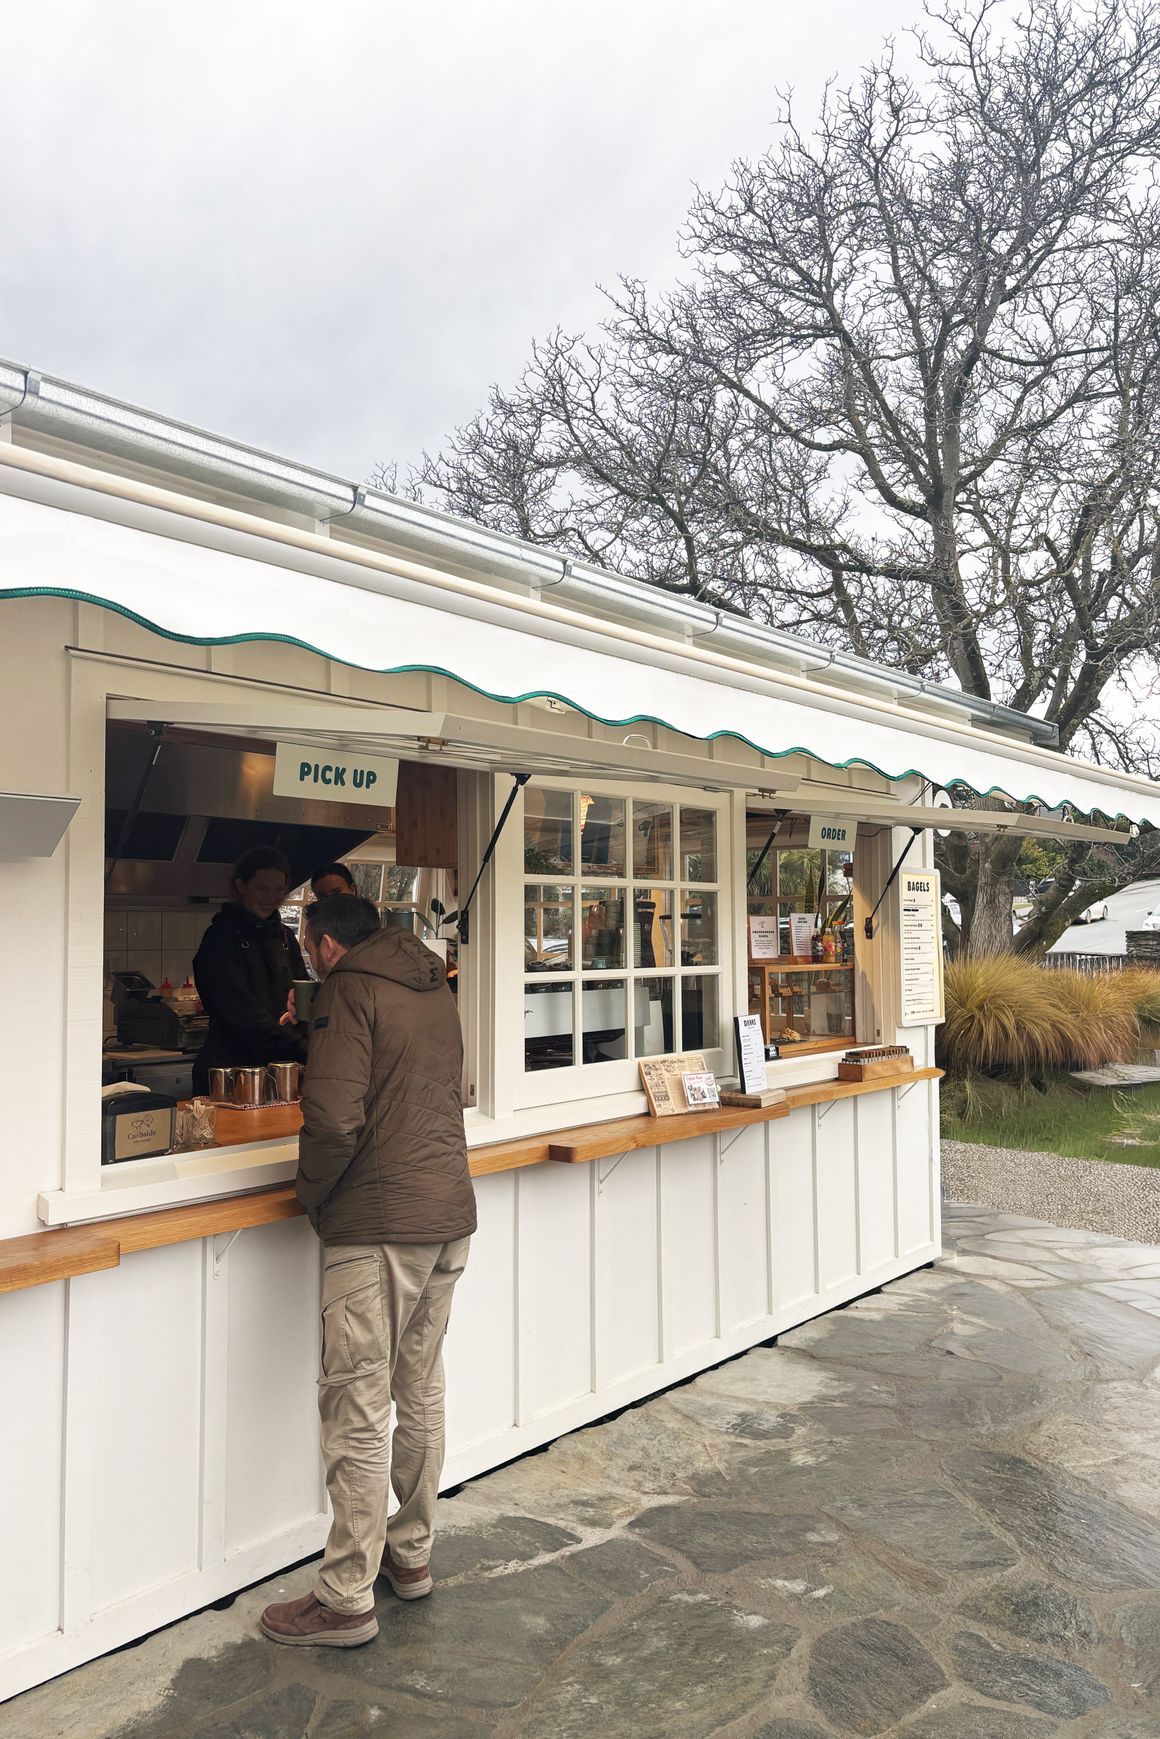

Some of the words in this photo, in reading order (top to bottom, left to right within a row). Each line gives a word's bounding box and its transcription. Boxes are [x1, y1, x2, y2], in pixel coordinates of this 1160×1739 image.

[299, 762, 347, 787] PICK
[353, 768, 378, 789] UP
[820, 826, 847, 842] ORDER
[907, 881, 930, 893] BAGELS
[127, 1129, 157, 1140] Curbside
